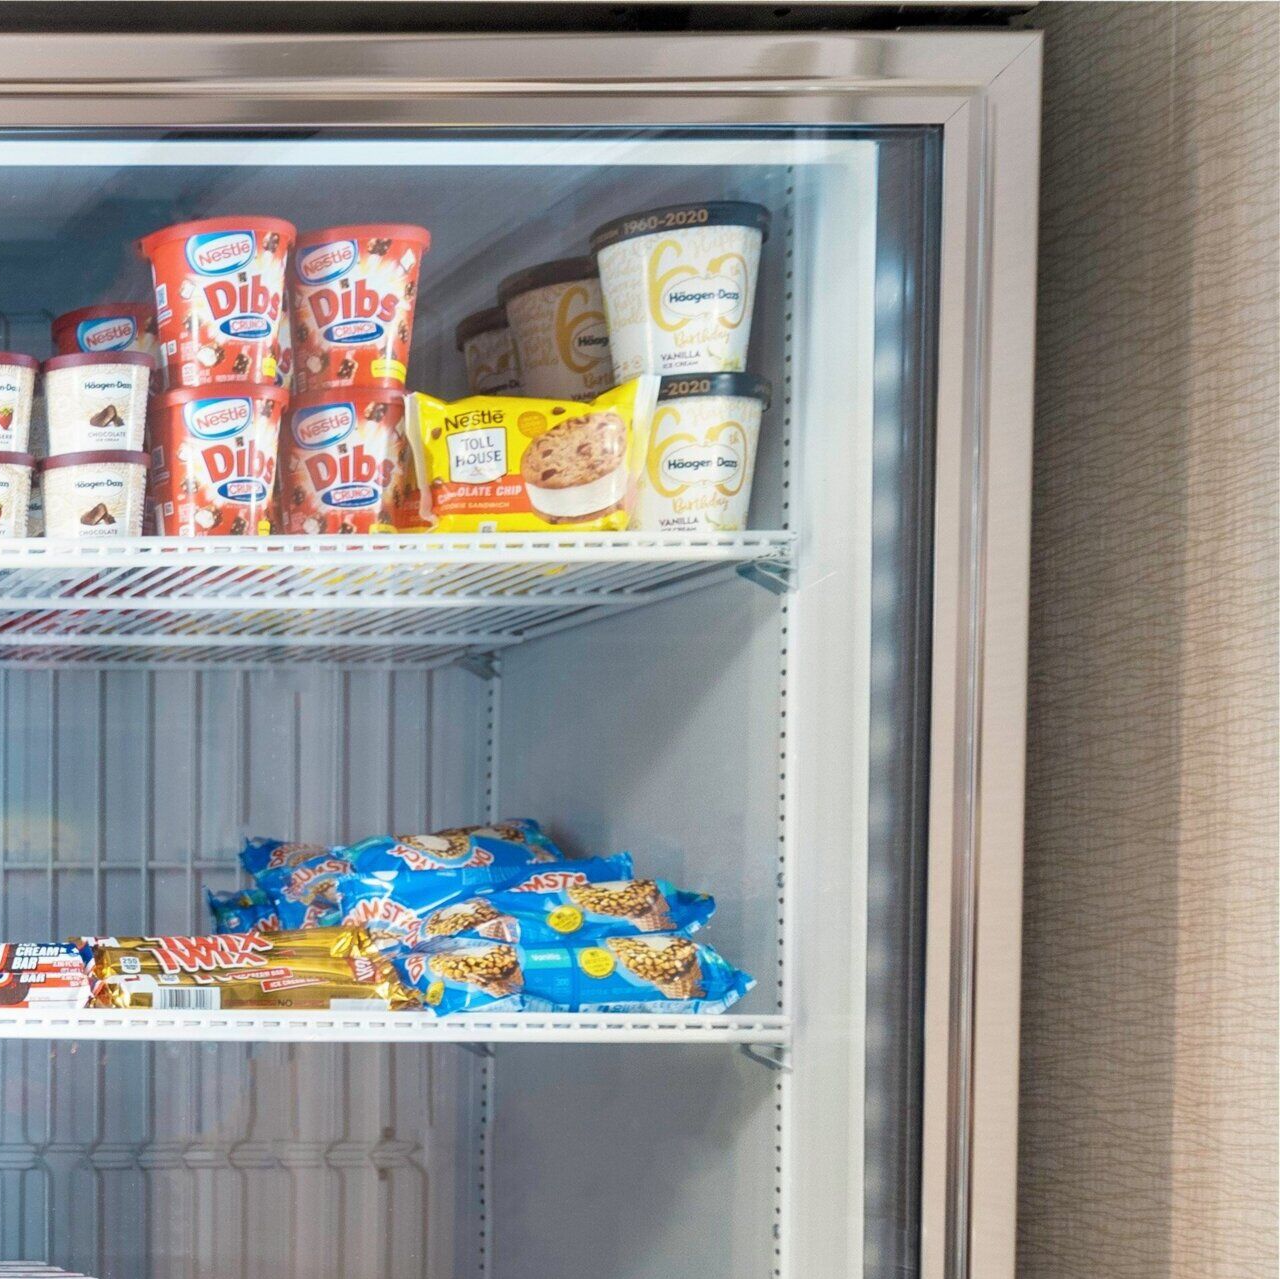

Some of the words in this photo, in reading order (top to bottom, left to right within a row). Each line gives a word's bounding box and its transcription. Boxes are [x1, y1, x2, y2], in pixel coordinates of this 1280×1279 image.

[624, 209, 709, 234] 1960-2020
[203, 280, 282, 322] Dibs
[308, 280, 400, 326] Dibs
[661, 351, 701, 361] VANILLA
[461, 436, 494, 449] TOLL
[202, 446, 277, 485] Dibs
[304, 445, 395, 485] Dibs
[455, 450, 502, 466] HOUSE
[496, 485, 522, 496] CHIP
[16, 946, 58, 956] CREAM
[12, 957, 38, 970] BAR
